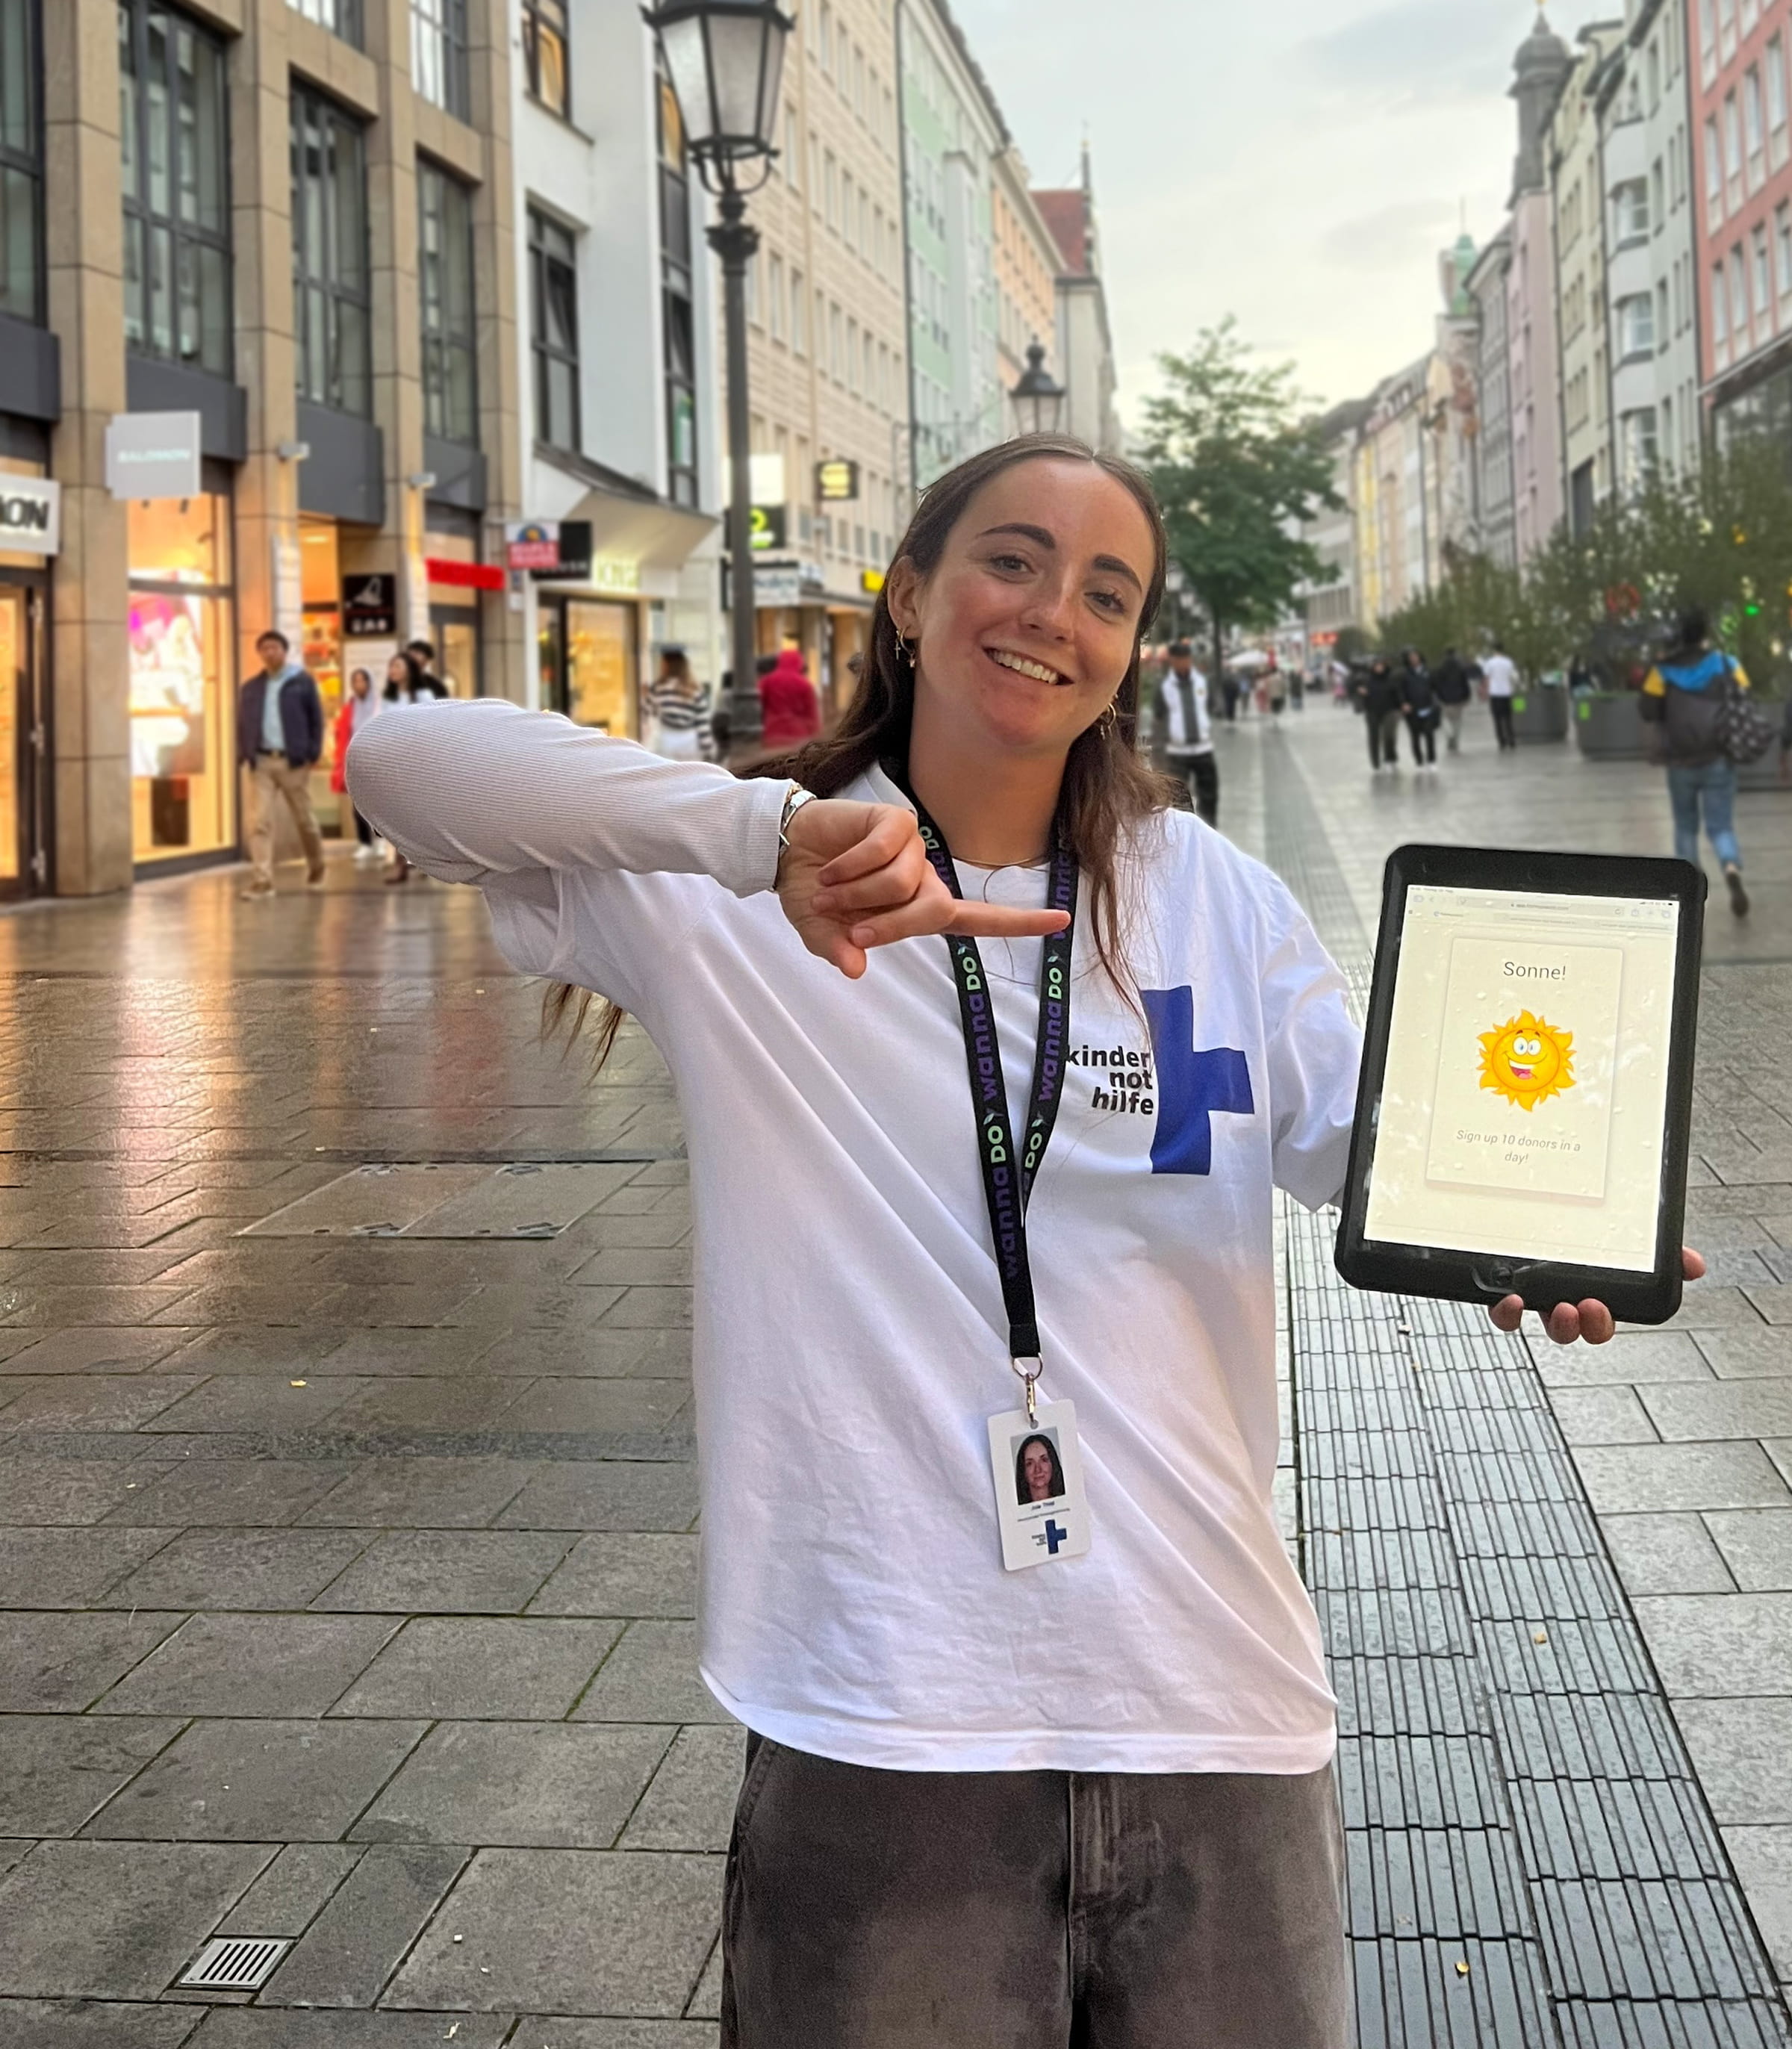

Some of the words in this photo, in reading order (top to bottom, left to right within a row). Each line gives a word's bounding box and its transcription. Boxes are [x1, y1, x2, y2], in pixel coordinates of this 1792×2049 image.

[0, 496, 49, 530] ON
[1503, 961, 1566, 980] Sonne!
[1068, 1045, 1151, 1068] kinder
[1110, 1069, 1153, 1089] not
[1092, 1086, 1154, 1115] hilfe
[1456, 1129, 1481, 1143] Sign
[1484, 1134, 1498, 1145] up
[1502, 1134, 1516, 1145] 10
[1518, 1136, 1558, 1150] donors
[1560, 1139, 1571, 1151] in
[1573, 1143, 1581, 1152] a
[1505, 1151, 1529, 1166] day!
